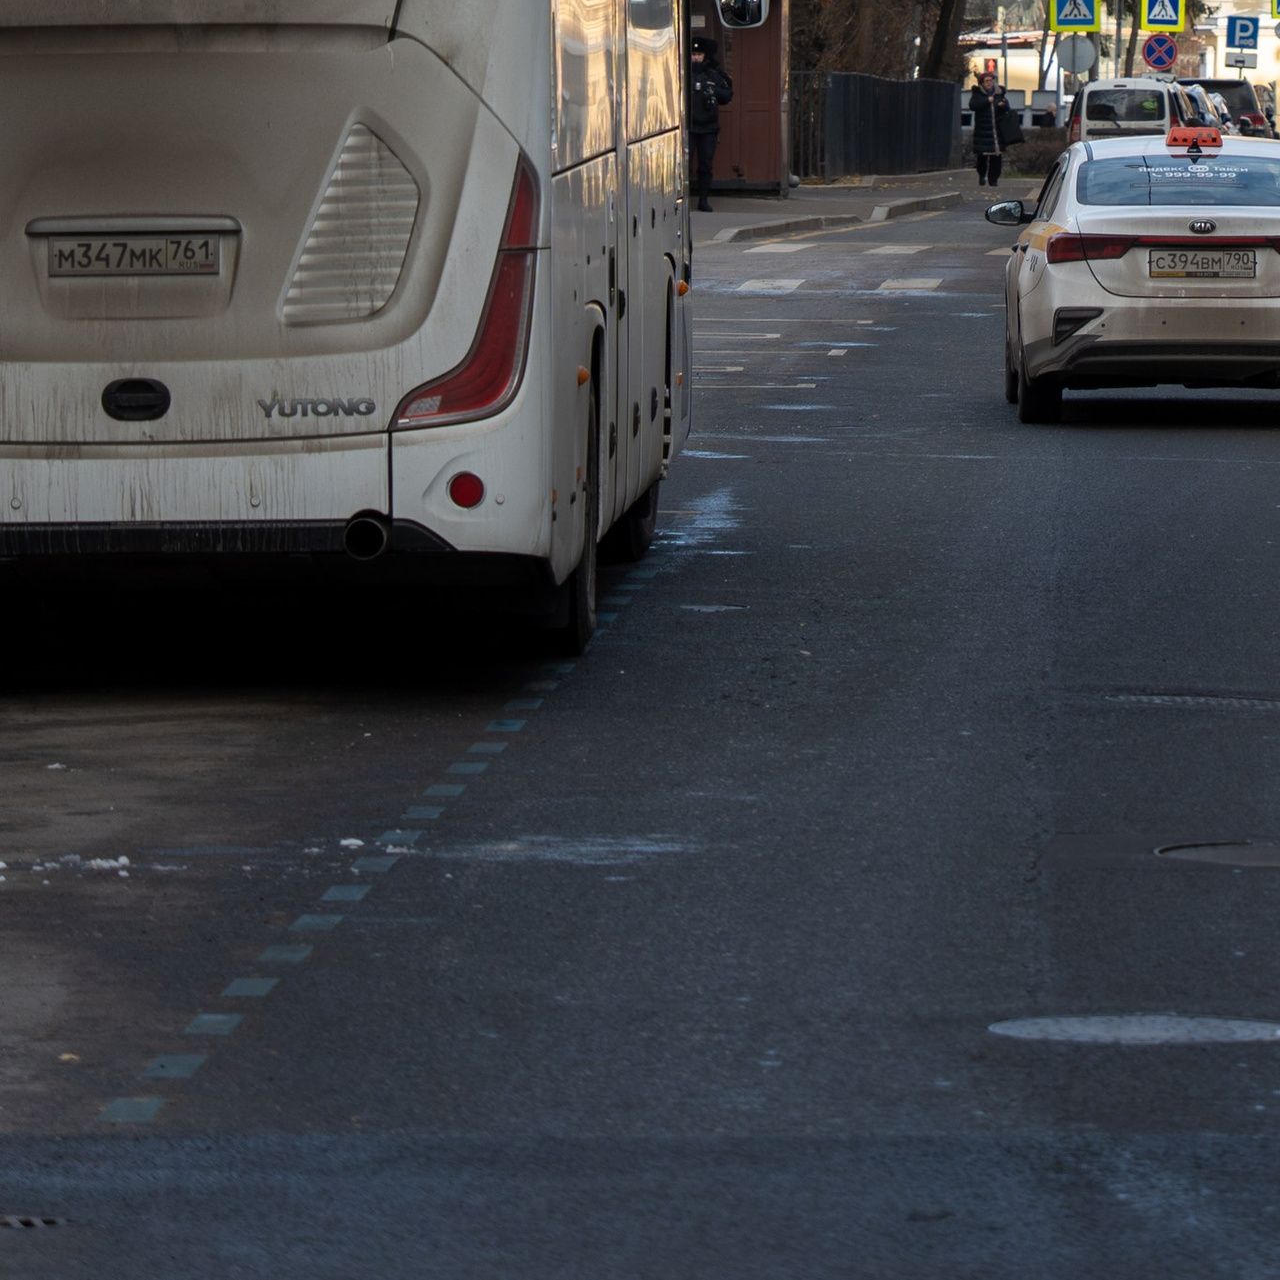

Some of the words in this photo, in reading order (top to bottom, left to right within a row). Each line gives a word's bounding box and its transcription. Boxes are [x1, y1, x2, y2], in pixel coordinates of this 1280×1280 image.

[1234, 19, 1254, 46] P
[1193, 222, 1212, 231] KIA
[170, 240, 209, 261] 761
[1225, 252, 1250, 265] 790
[178, 261, 199, 269] RUS
[257, 398, 376, 418] YUTONG
